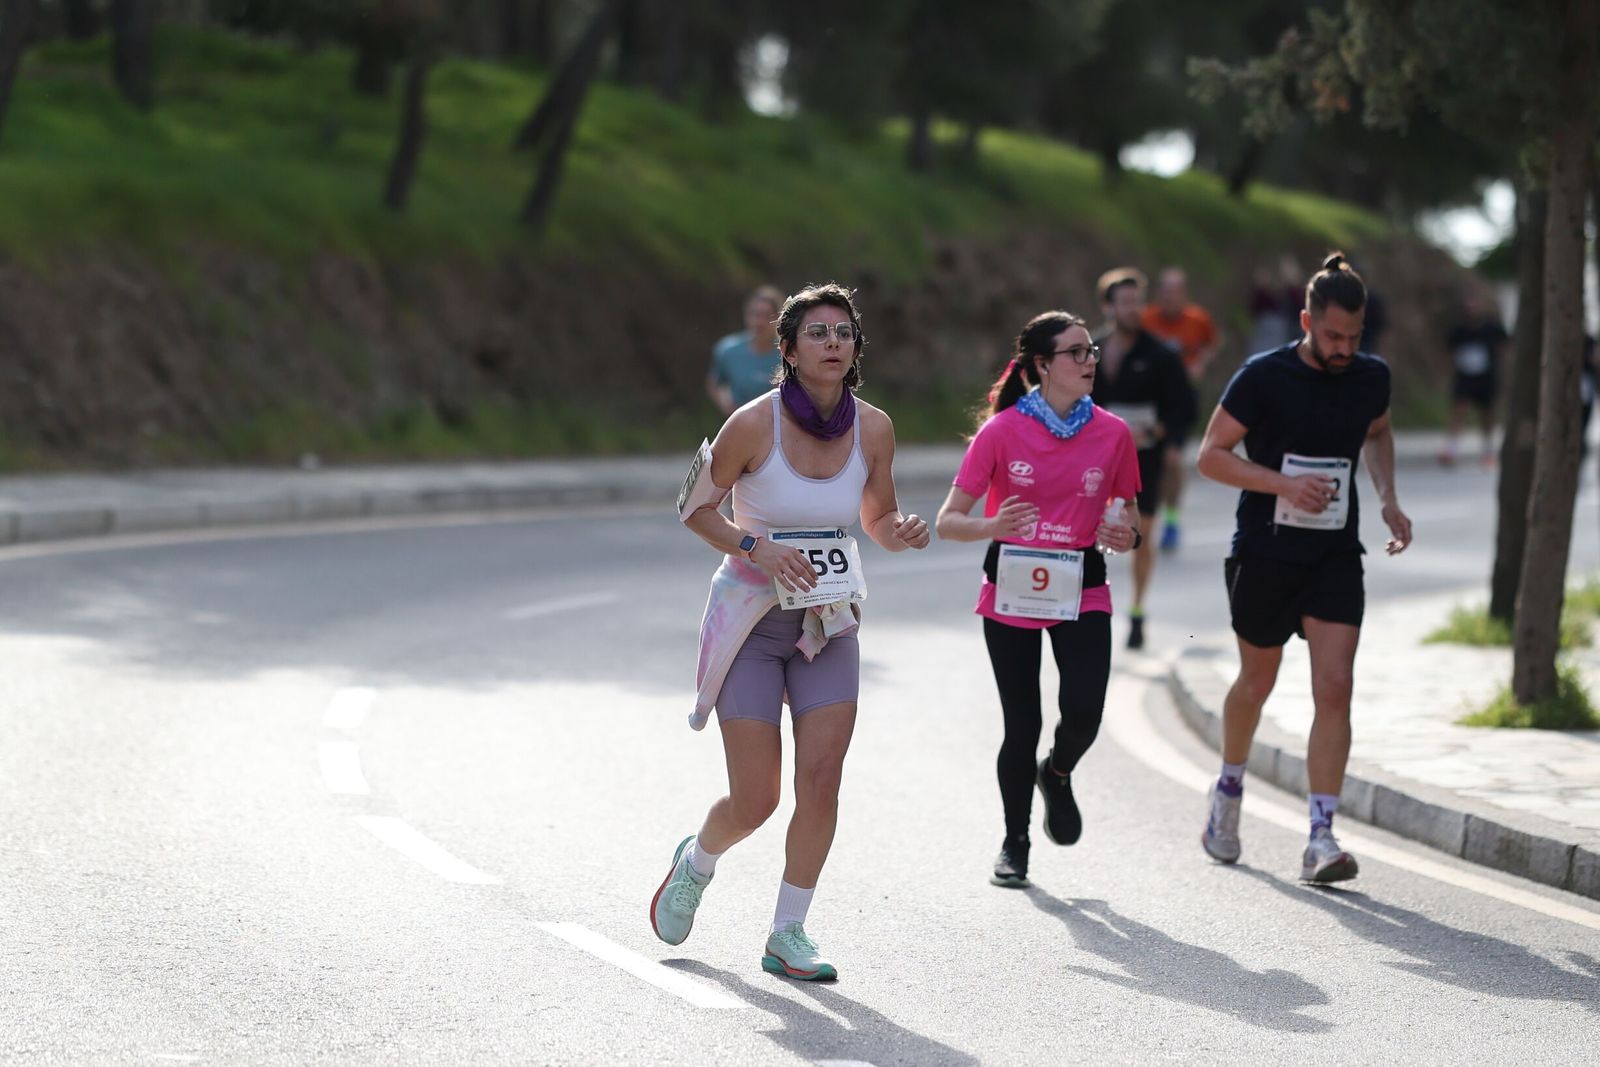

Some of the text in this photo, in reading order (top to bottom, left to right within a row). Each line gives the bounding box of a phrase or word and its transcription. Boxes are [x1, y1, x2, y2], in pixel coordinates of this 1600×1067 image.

[1039, 532, 1049, 540] de
[1041, 522, 1071, 534] Ciudad
[797, 548, 849, 577] 59
[1032, 567, 1050, 592] 9
